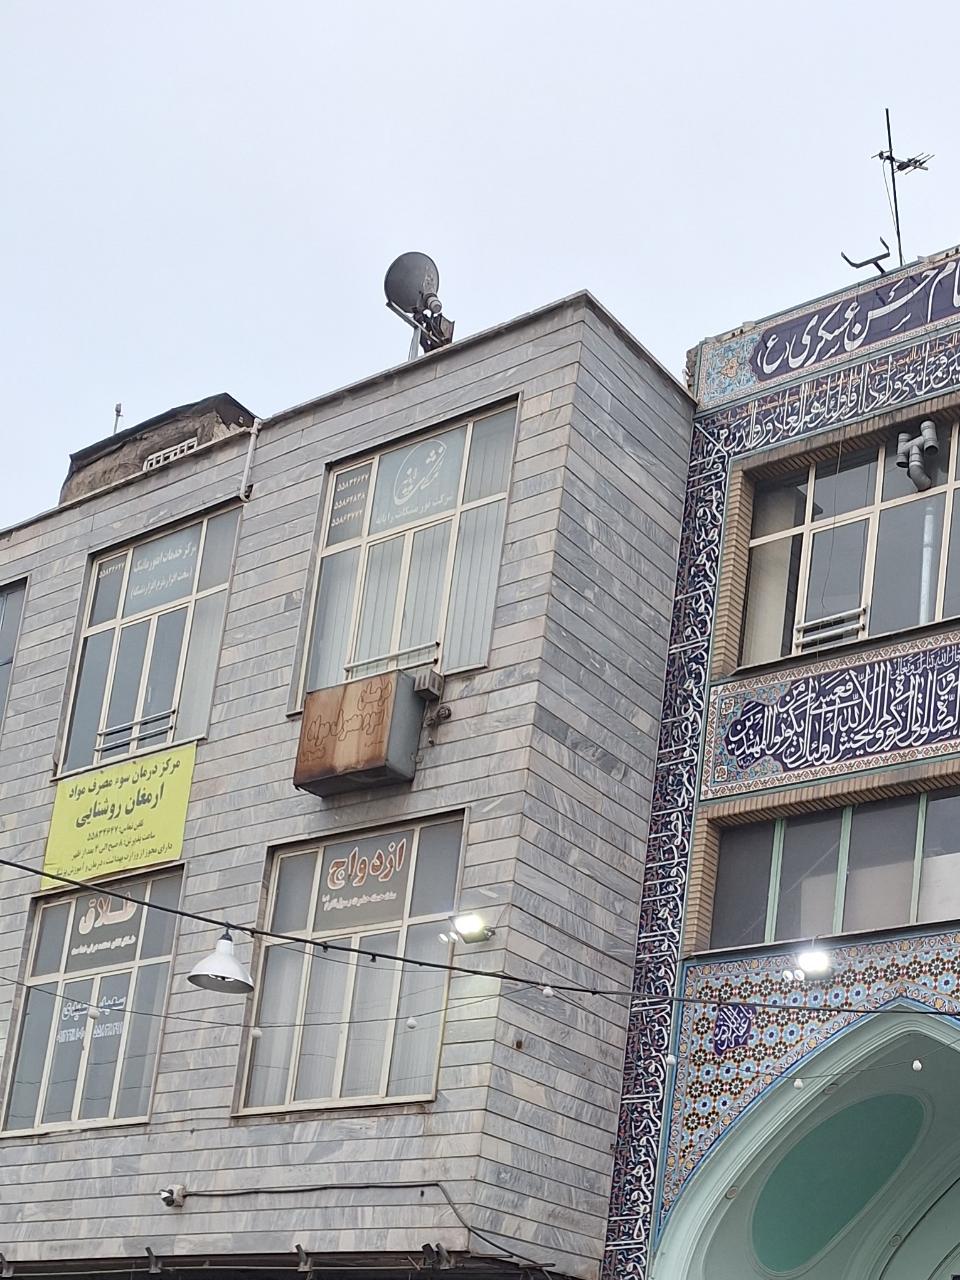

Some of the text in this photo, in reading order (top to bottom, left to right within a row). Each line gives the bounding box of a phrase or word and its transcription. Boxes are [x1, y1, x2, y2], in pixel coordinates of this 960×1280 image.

[844, 267, 940, 351] حسن
[787, 302, 860, 369] عسکری
[132, 764, 158, 784] درمان
[160, 758, 181, 777] مرکز
[68, 784, 86, 800] مواد
[88, 778, 113, 795] مصرف
[75, 782, 165, 828] ارمغان روشنایی
[327, 838, 406, 890] ازدواج
